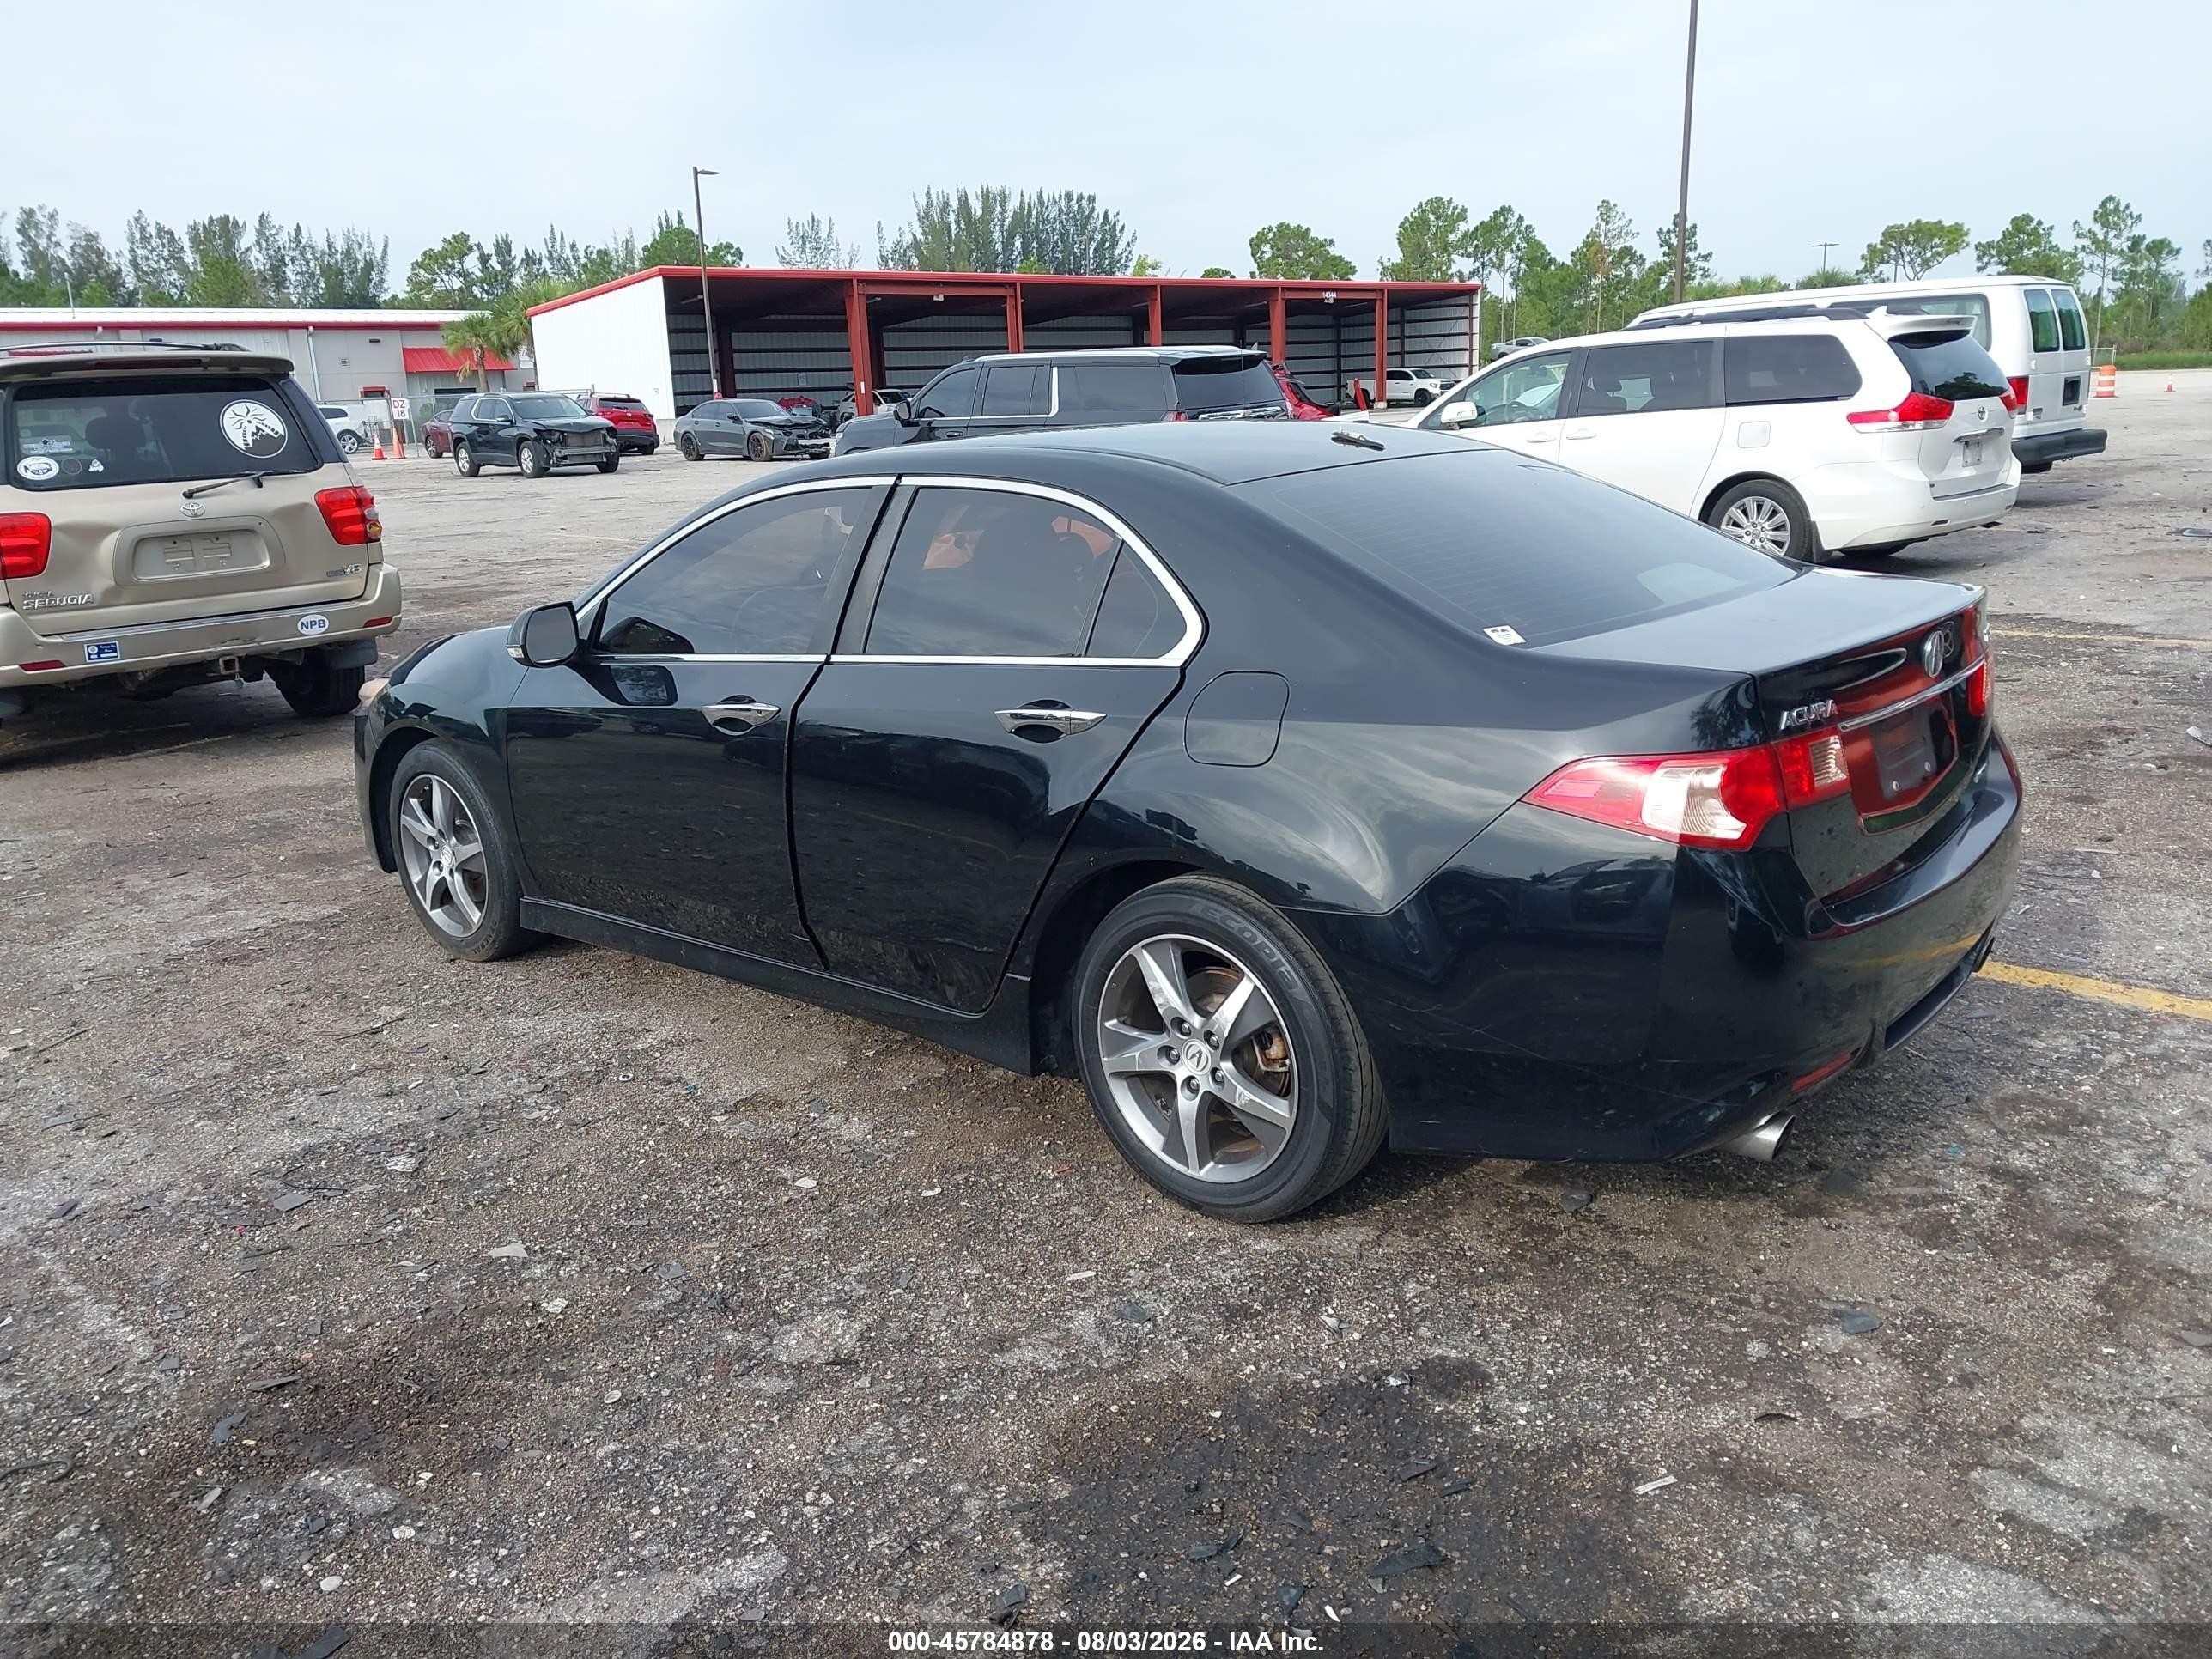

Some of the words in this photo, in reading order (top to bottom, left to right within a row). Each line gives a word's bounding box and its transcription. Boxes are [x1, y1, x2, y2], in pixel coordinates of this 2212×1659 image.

[392, 399, 405, 409] DZ
[22, 594, 94, 610] SEQUOIA
[301, 619, 326, 630] NPB
[1779, 700, 1839, 730] ACURA
